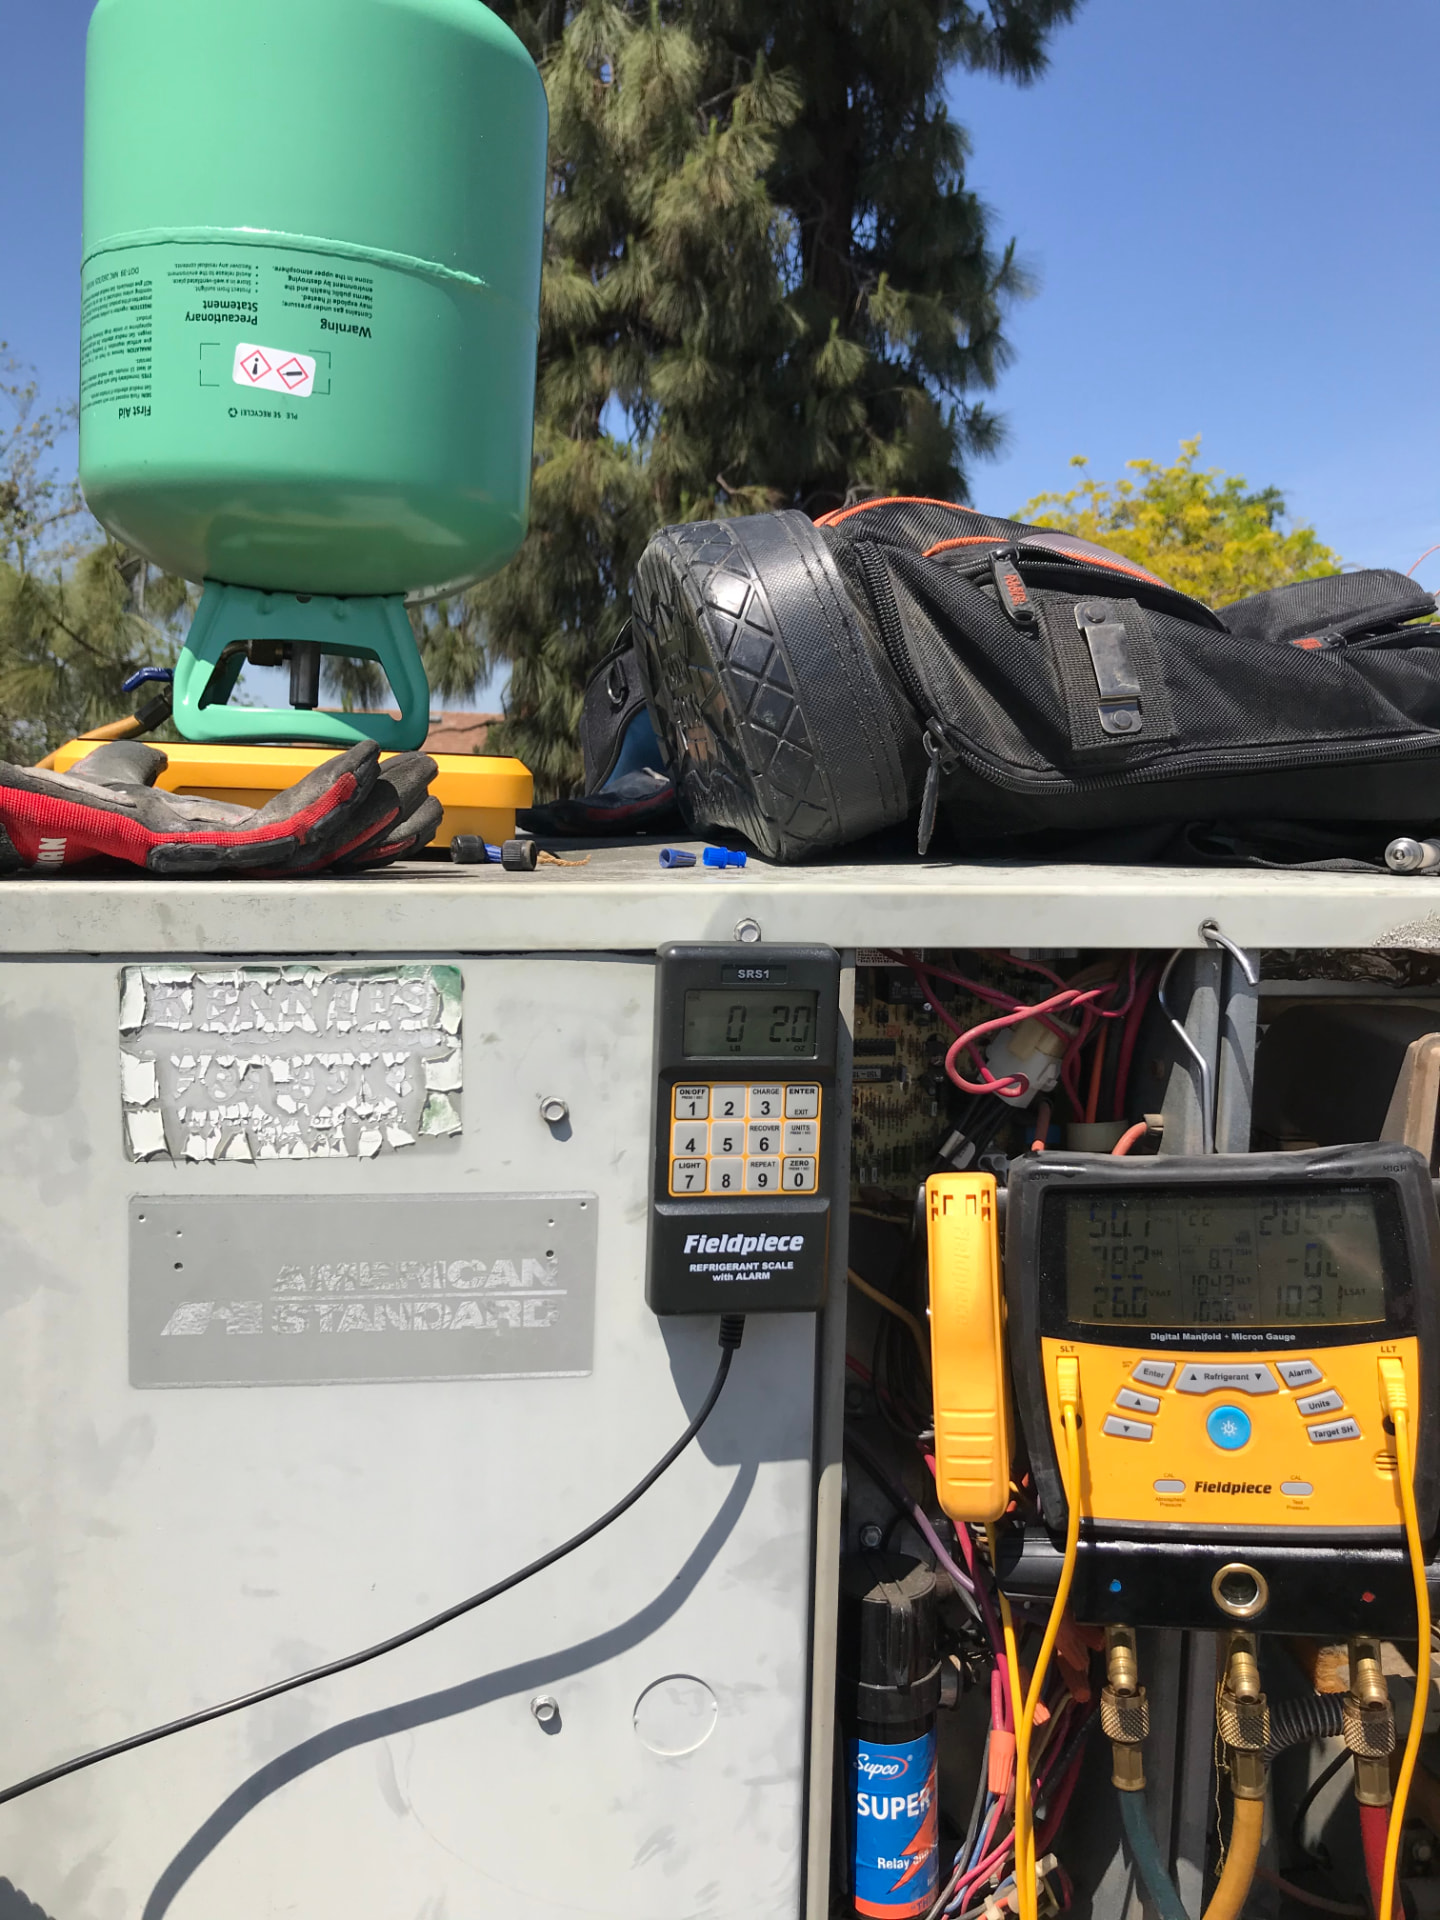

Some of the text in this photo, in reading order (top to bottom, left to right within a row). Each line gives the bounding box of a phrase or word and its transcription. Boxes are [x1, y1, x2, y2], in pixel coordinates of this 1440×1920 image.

[272, 266, 313, 275] atmosphere.
[288, 275, 322, 285] destroying
[333, 282, 373, 292] environment
[301, 295, 325, 303] heated.
[333, 299, 358, 307] explode
[203, 301, 258, 313] Statement
[185, 312, 258, 326] Precautionary
[345, 309, 372, 319] Contains
[320, 319, 372, 339] Warning
[118, 406, 151, 419] First Aid
[737, 969, 770, 979] SRS1
[726, 1006, 811, 1043] 0 2.0
[689, 1102, 696, 1116] 1
[725, 1101, 734, 1116] 2
[761, 1101, 770, 1115] 3
[685, 1138, 696, 1152] 4
[723, 1138, 733, 1152] 5
[759, 1137, 769, 1151] 6
[685, 1175, 694, 1189] 7
[722, 1174, 731, 1188] 8
[758, 1173, 768, 1187] 9
[794, 1173, 804, 1187] 0
[684, 1233, 804, 1255] Fieldpiece
[689, 1262, 794, 1272] REFRIGERANT SCALE
[272, 1257, 559, 1293] AMERICAN
[712, 1272, 770, 1281] with ALARM
[271, 1297, 561, 1335] STANDARD
[1151, 1332, 1296, 1342] Digital Manifold Micron Gauge
[1059, 1345, 1075, 1353] SLT
[1380, 1345, 1397, 1353] LLT
[1143, 1367, 1165, 1380] Enter
[1204, 1372, 1249, 1384] Refrigerant
[1288, 1367, 1312, 1378] Alarm
[1308, 1399, 1331, 1410] Units
[1312, 1426, 1354, 1438] Target SH
[1194, 1481, 1272, 1495] Fieldpiece
[853, 1753, 899, 1780] Supco
[857, 1787, 931, 1820] SUPER
[878, 1857, 909, 1870] Relay
